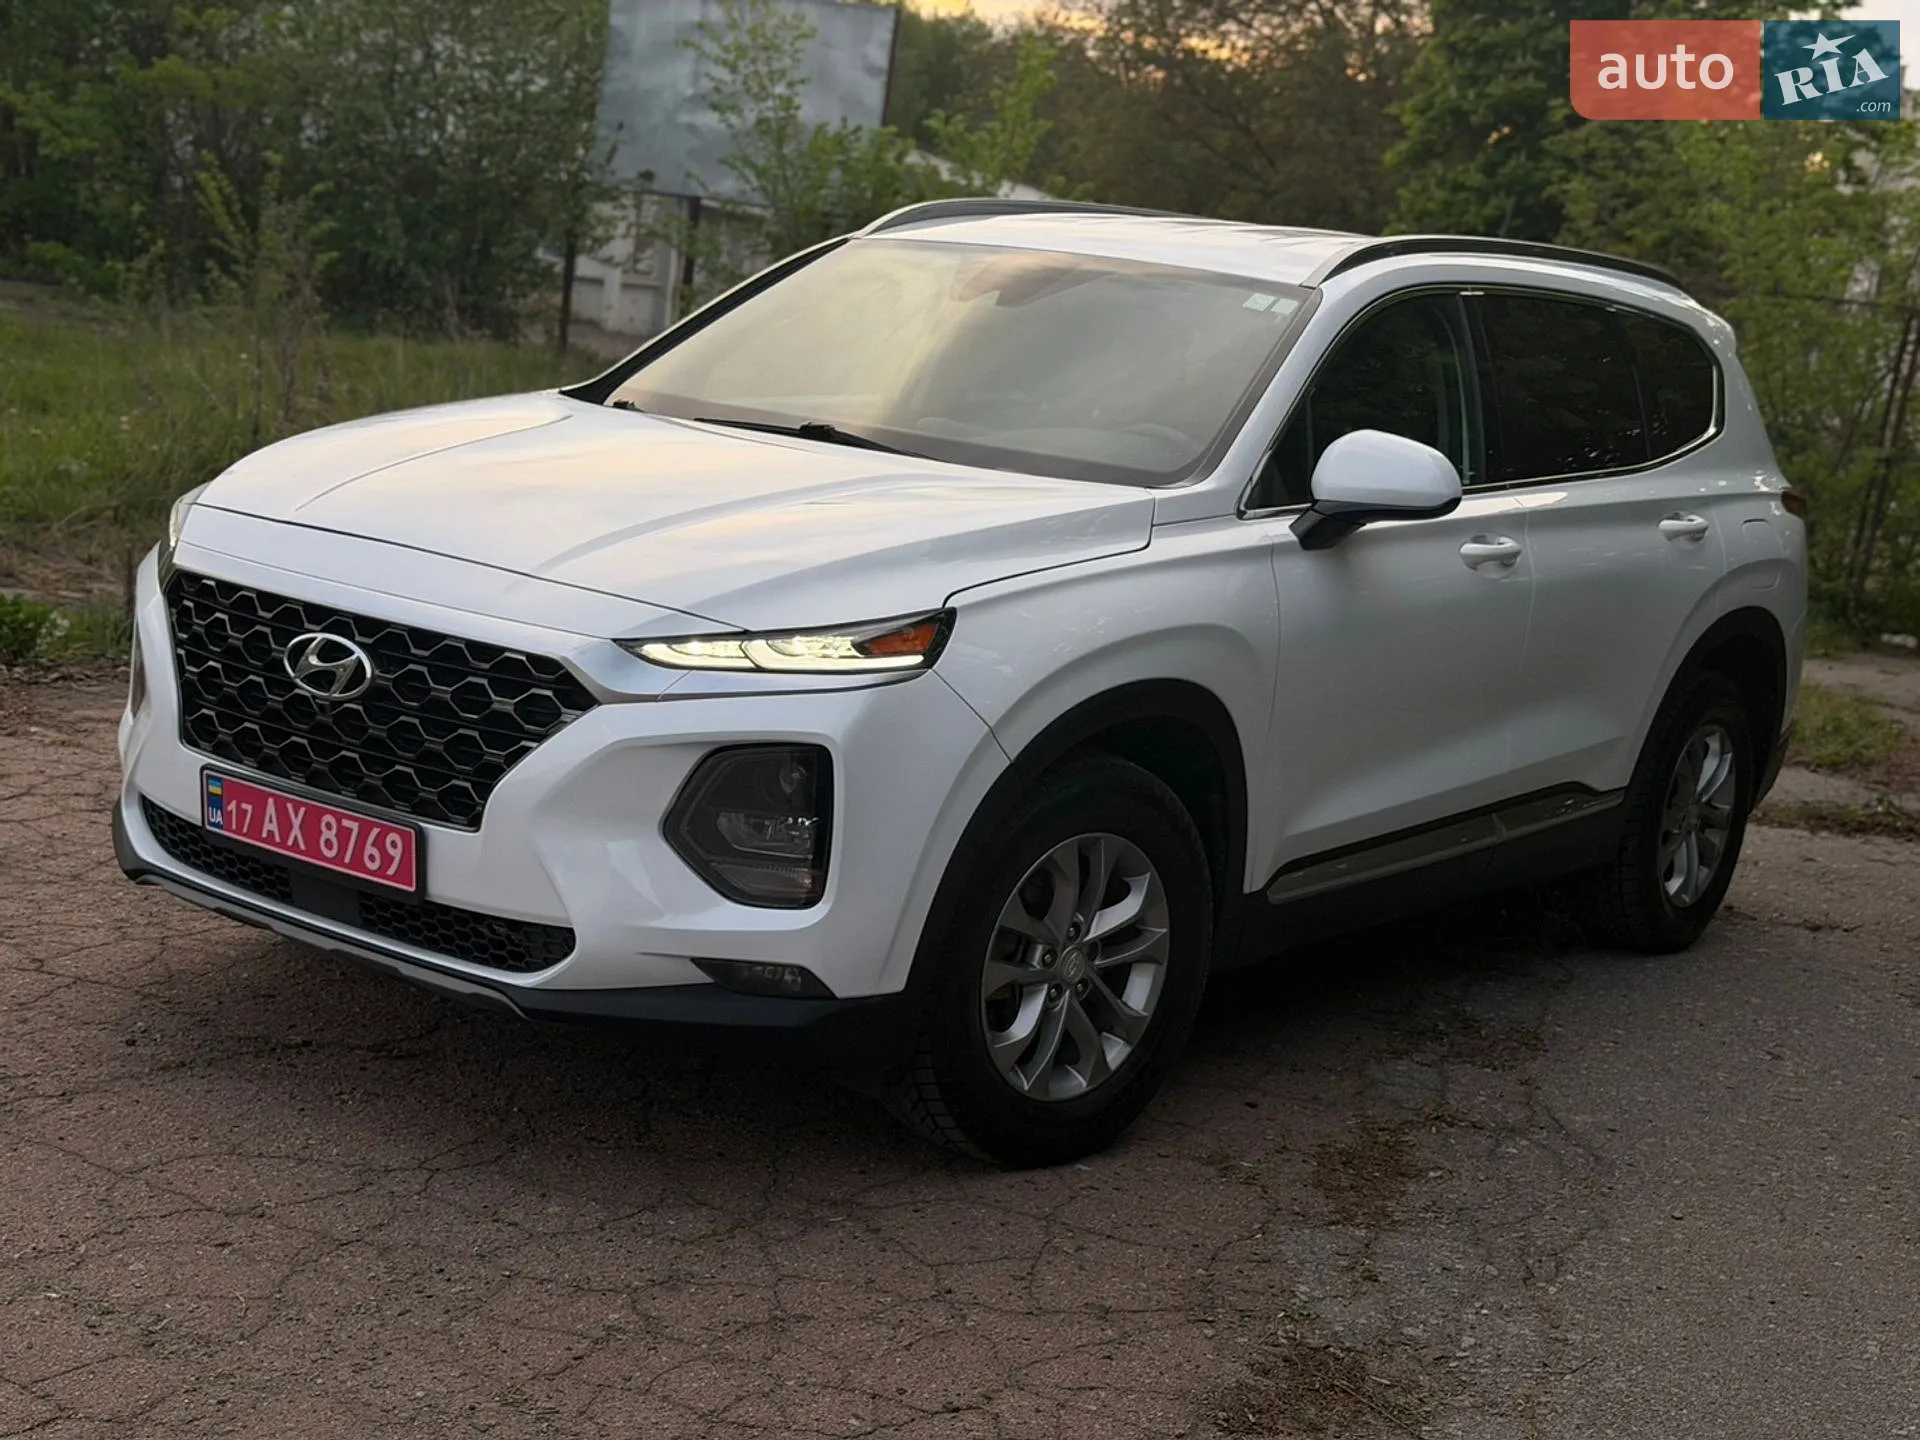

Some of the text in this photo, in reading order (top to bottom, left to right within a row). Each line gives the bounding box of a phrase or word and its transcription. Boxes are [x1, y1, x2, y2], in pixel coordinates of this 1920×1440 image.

[208, 806, 224, 826] UA
[227, 797, 404, 876] 17 AX 8769
